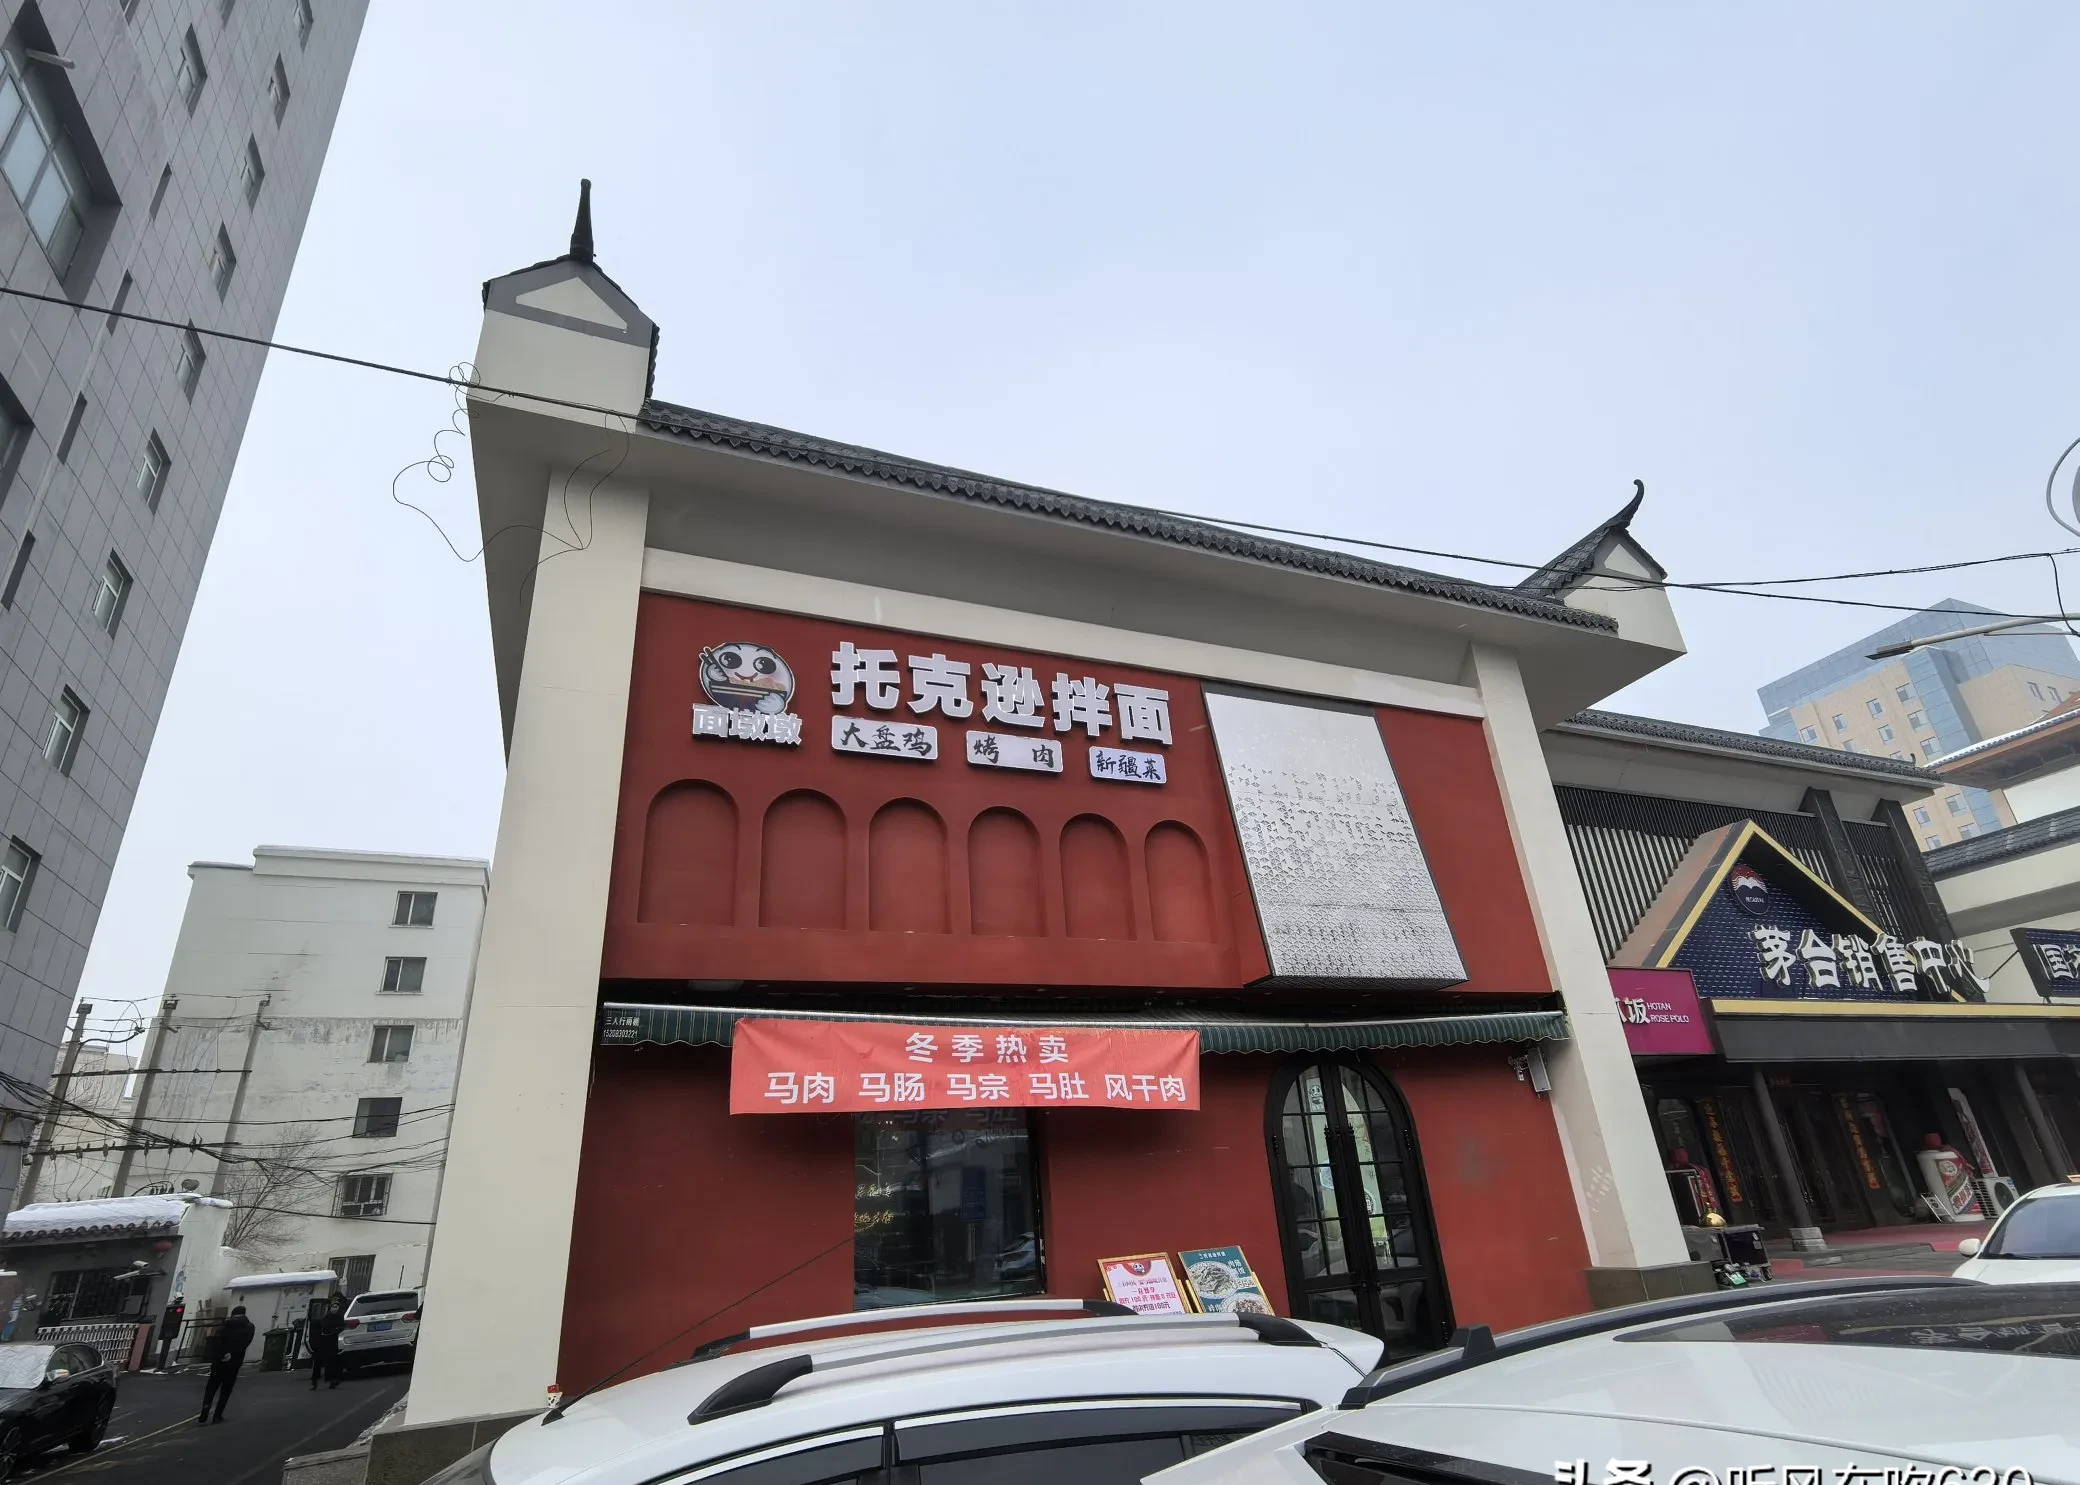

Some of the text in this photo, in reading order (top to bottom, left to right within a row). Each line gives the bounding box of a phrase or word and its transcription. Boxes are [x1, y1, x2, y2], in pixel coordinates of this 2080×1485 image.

[831, 641, 1173, 746] 托克逊拌面
[692, 703, 803, 746] 面墩墩
[841, 722, 933, 757] 大盘鸡
[1096, 750, 1161, 781] 新疆菜
[1748, 923, 1990, 994] 茅台销售中心
[1646, 1002, 1672, 1011] HOTAN
[1650, 1014, 1690, 1023] ROSE POLO
[904, 1032, 1069, 1064] 冬季热卖
[763, 1071, 1187, 1104] 马肉 马肠 马宗 马肚 风干肉
